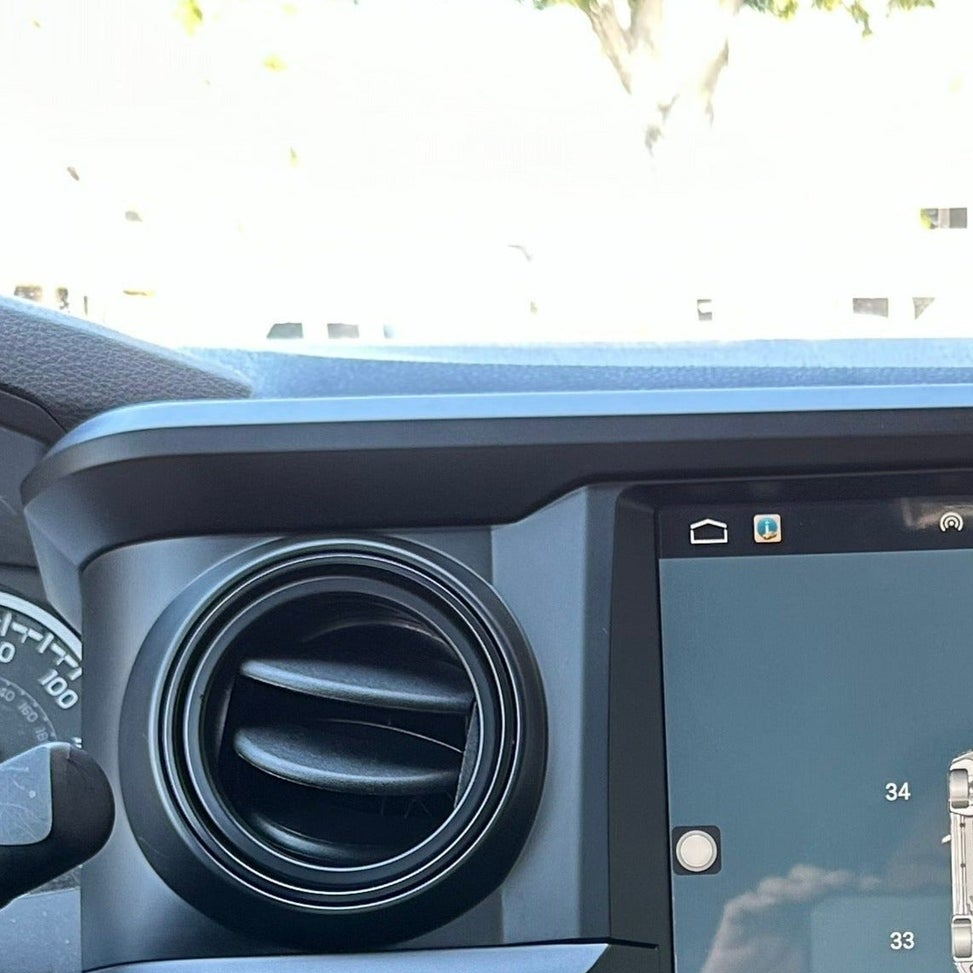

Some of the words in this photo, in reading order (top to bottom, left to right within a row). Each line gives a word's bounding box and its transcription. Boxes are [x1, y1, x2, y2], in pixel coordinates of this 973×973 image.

[0, 641, 16, 663] 0
[39, 668, 79, 709] 100
[18, 702, 39, 723] 160
[885, 782, 911, 802] 34
[890, 931, 915, 950] 33
